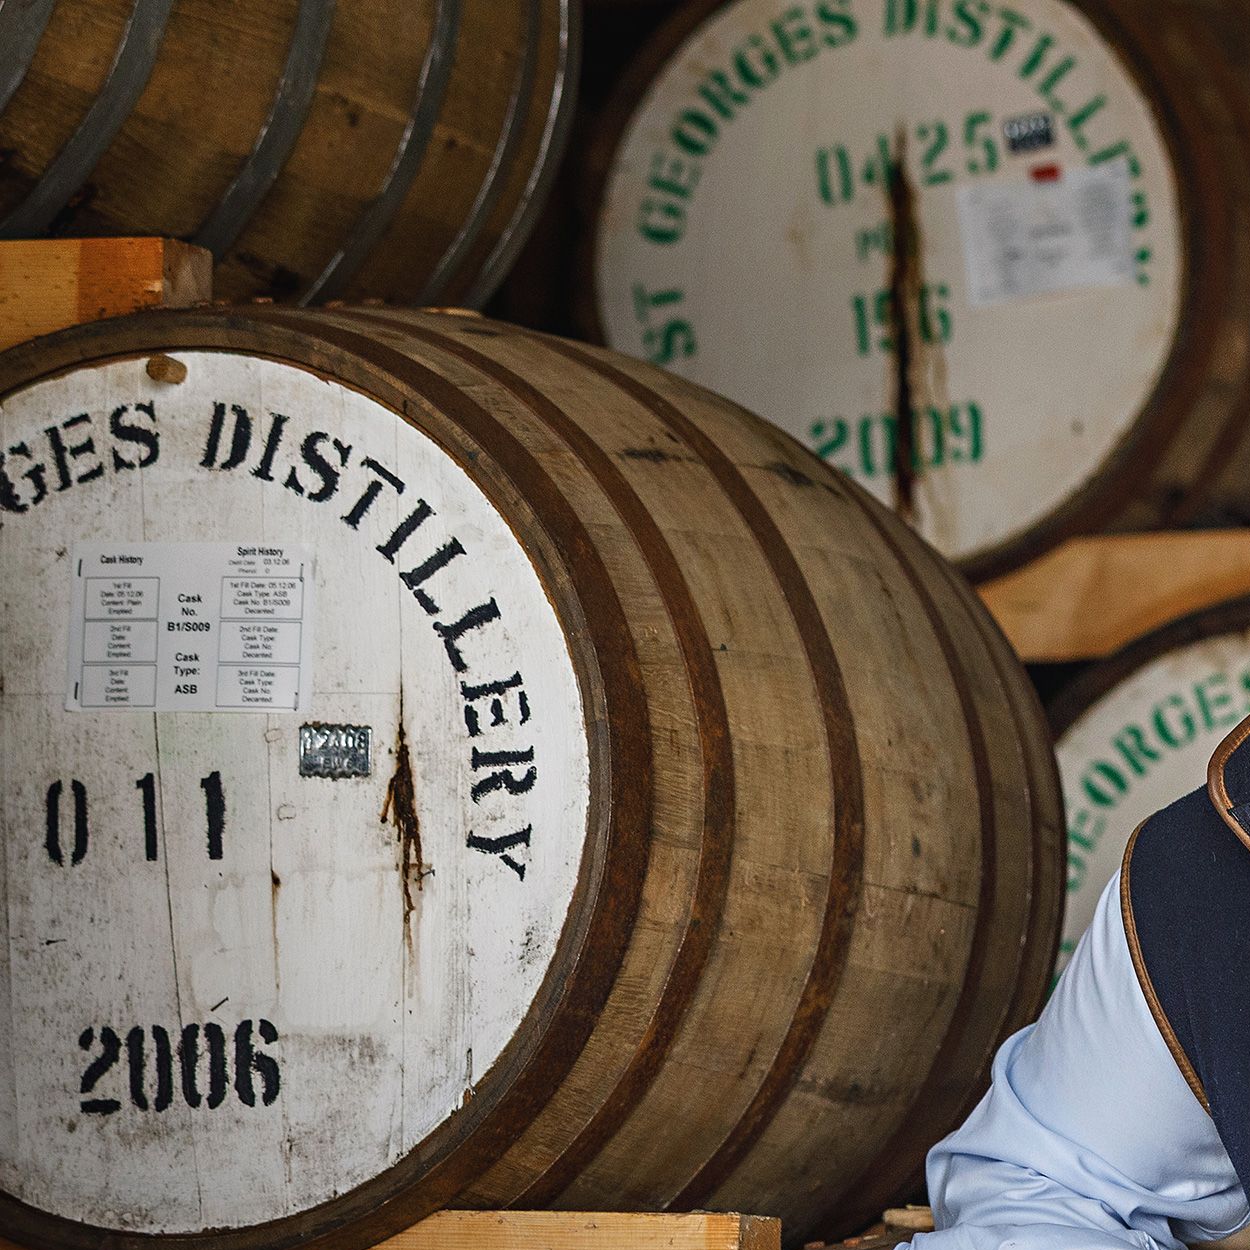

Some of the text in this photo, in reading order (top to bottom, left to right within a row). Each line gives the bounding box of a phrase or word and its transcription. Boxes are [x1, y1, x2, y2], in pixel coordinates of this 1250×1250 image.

[632, 279, 698, 365] ST
[258, 546, 284, 558] History
[119, 555, 144, 566] History
[178, 594, 203, 604] Cask
[181, 607, 198, 617] No.
[167, 622, 211, 632] B1/S009
[200, 402, 537, 881] DISTILLERY
[175, 652, 200, 662] Cask
[174, 666, 200, 677] Type:
[174, 684, 198, 694] ASB
[45, 771, 226, 867] 011
[78, 1018, 281, 1115] 2006
